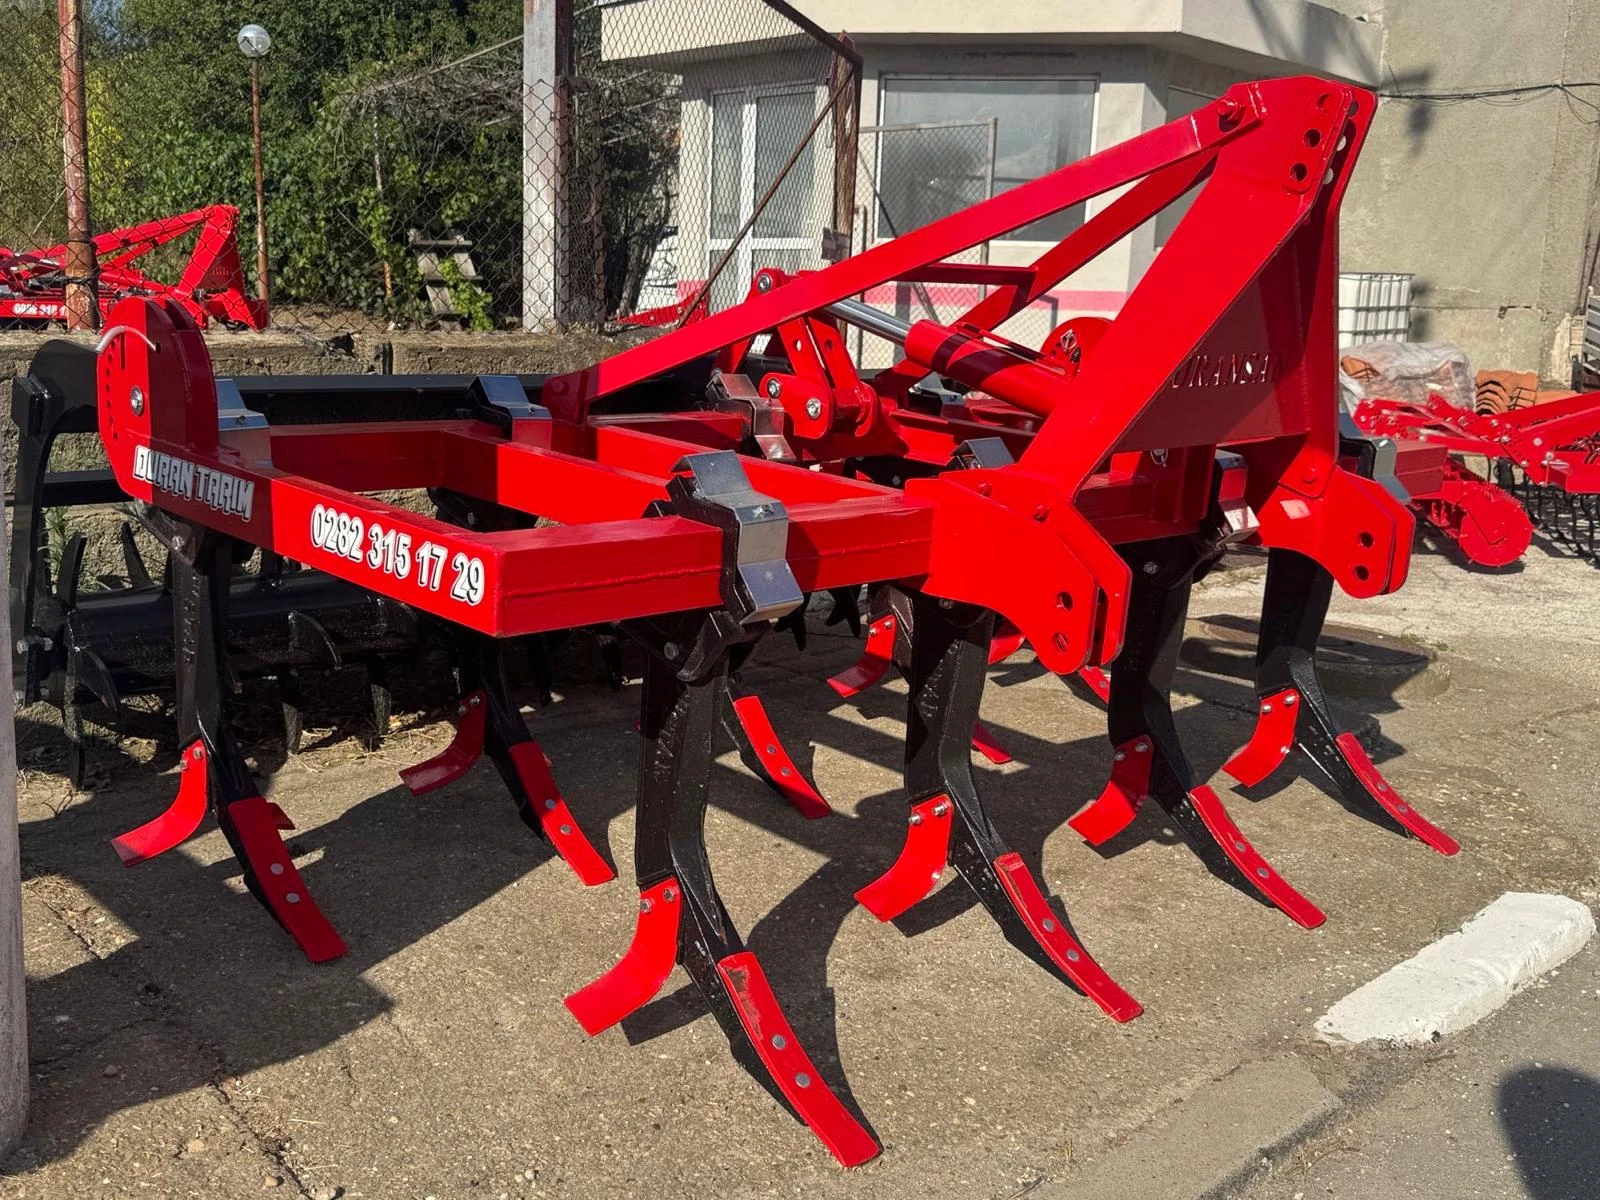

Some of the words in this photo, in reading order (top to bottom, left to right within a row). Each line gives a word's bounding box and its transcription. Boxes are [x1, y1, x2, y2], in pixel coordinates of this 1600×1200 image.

[133, 446, 195, 500] DURAN
[195, 464, 254, 521] TARIM
[311, 505, 364, 562] 0282
[368, 523, 412, 578] 315
[416, 541, 448, 591] 17
[450, 553, 485, 607] 29
